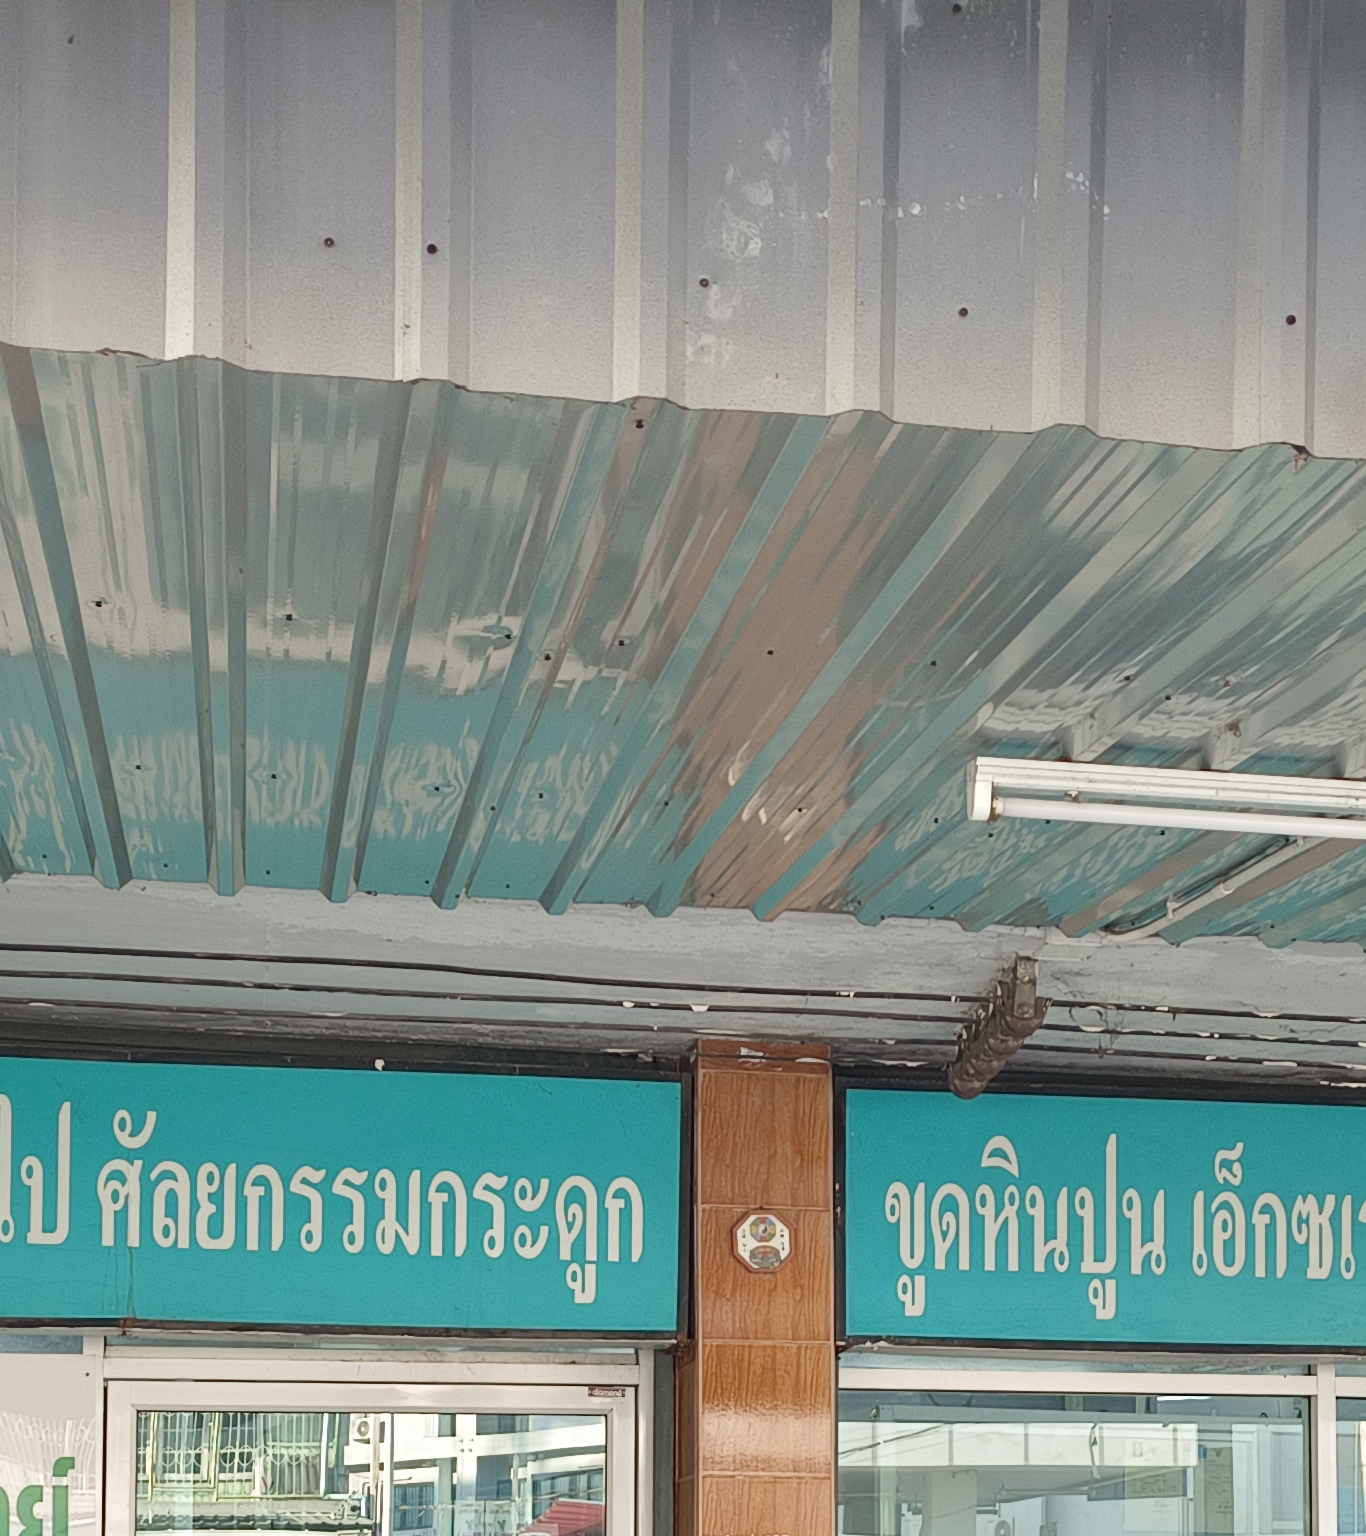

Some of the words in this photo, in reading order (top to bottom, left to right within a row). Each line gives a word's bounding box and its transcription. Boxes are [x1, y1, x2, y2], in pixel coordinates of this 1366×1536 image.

[97, 1109, 644, 1303] ศัลยกรรมกระดูก
[884, 1133, 1166, 1320] ขูดหินปูน
